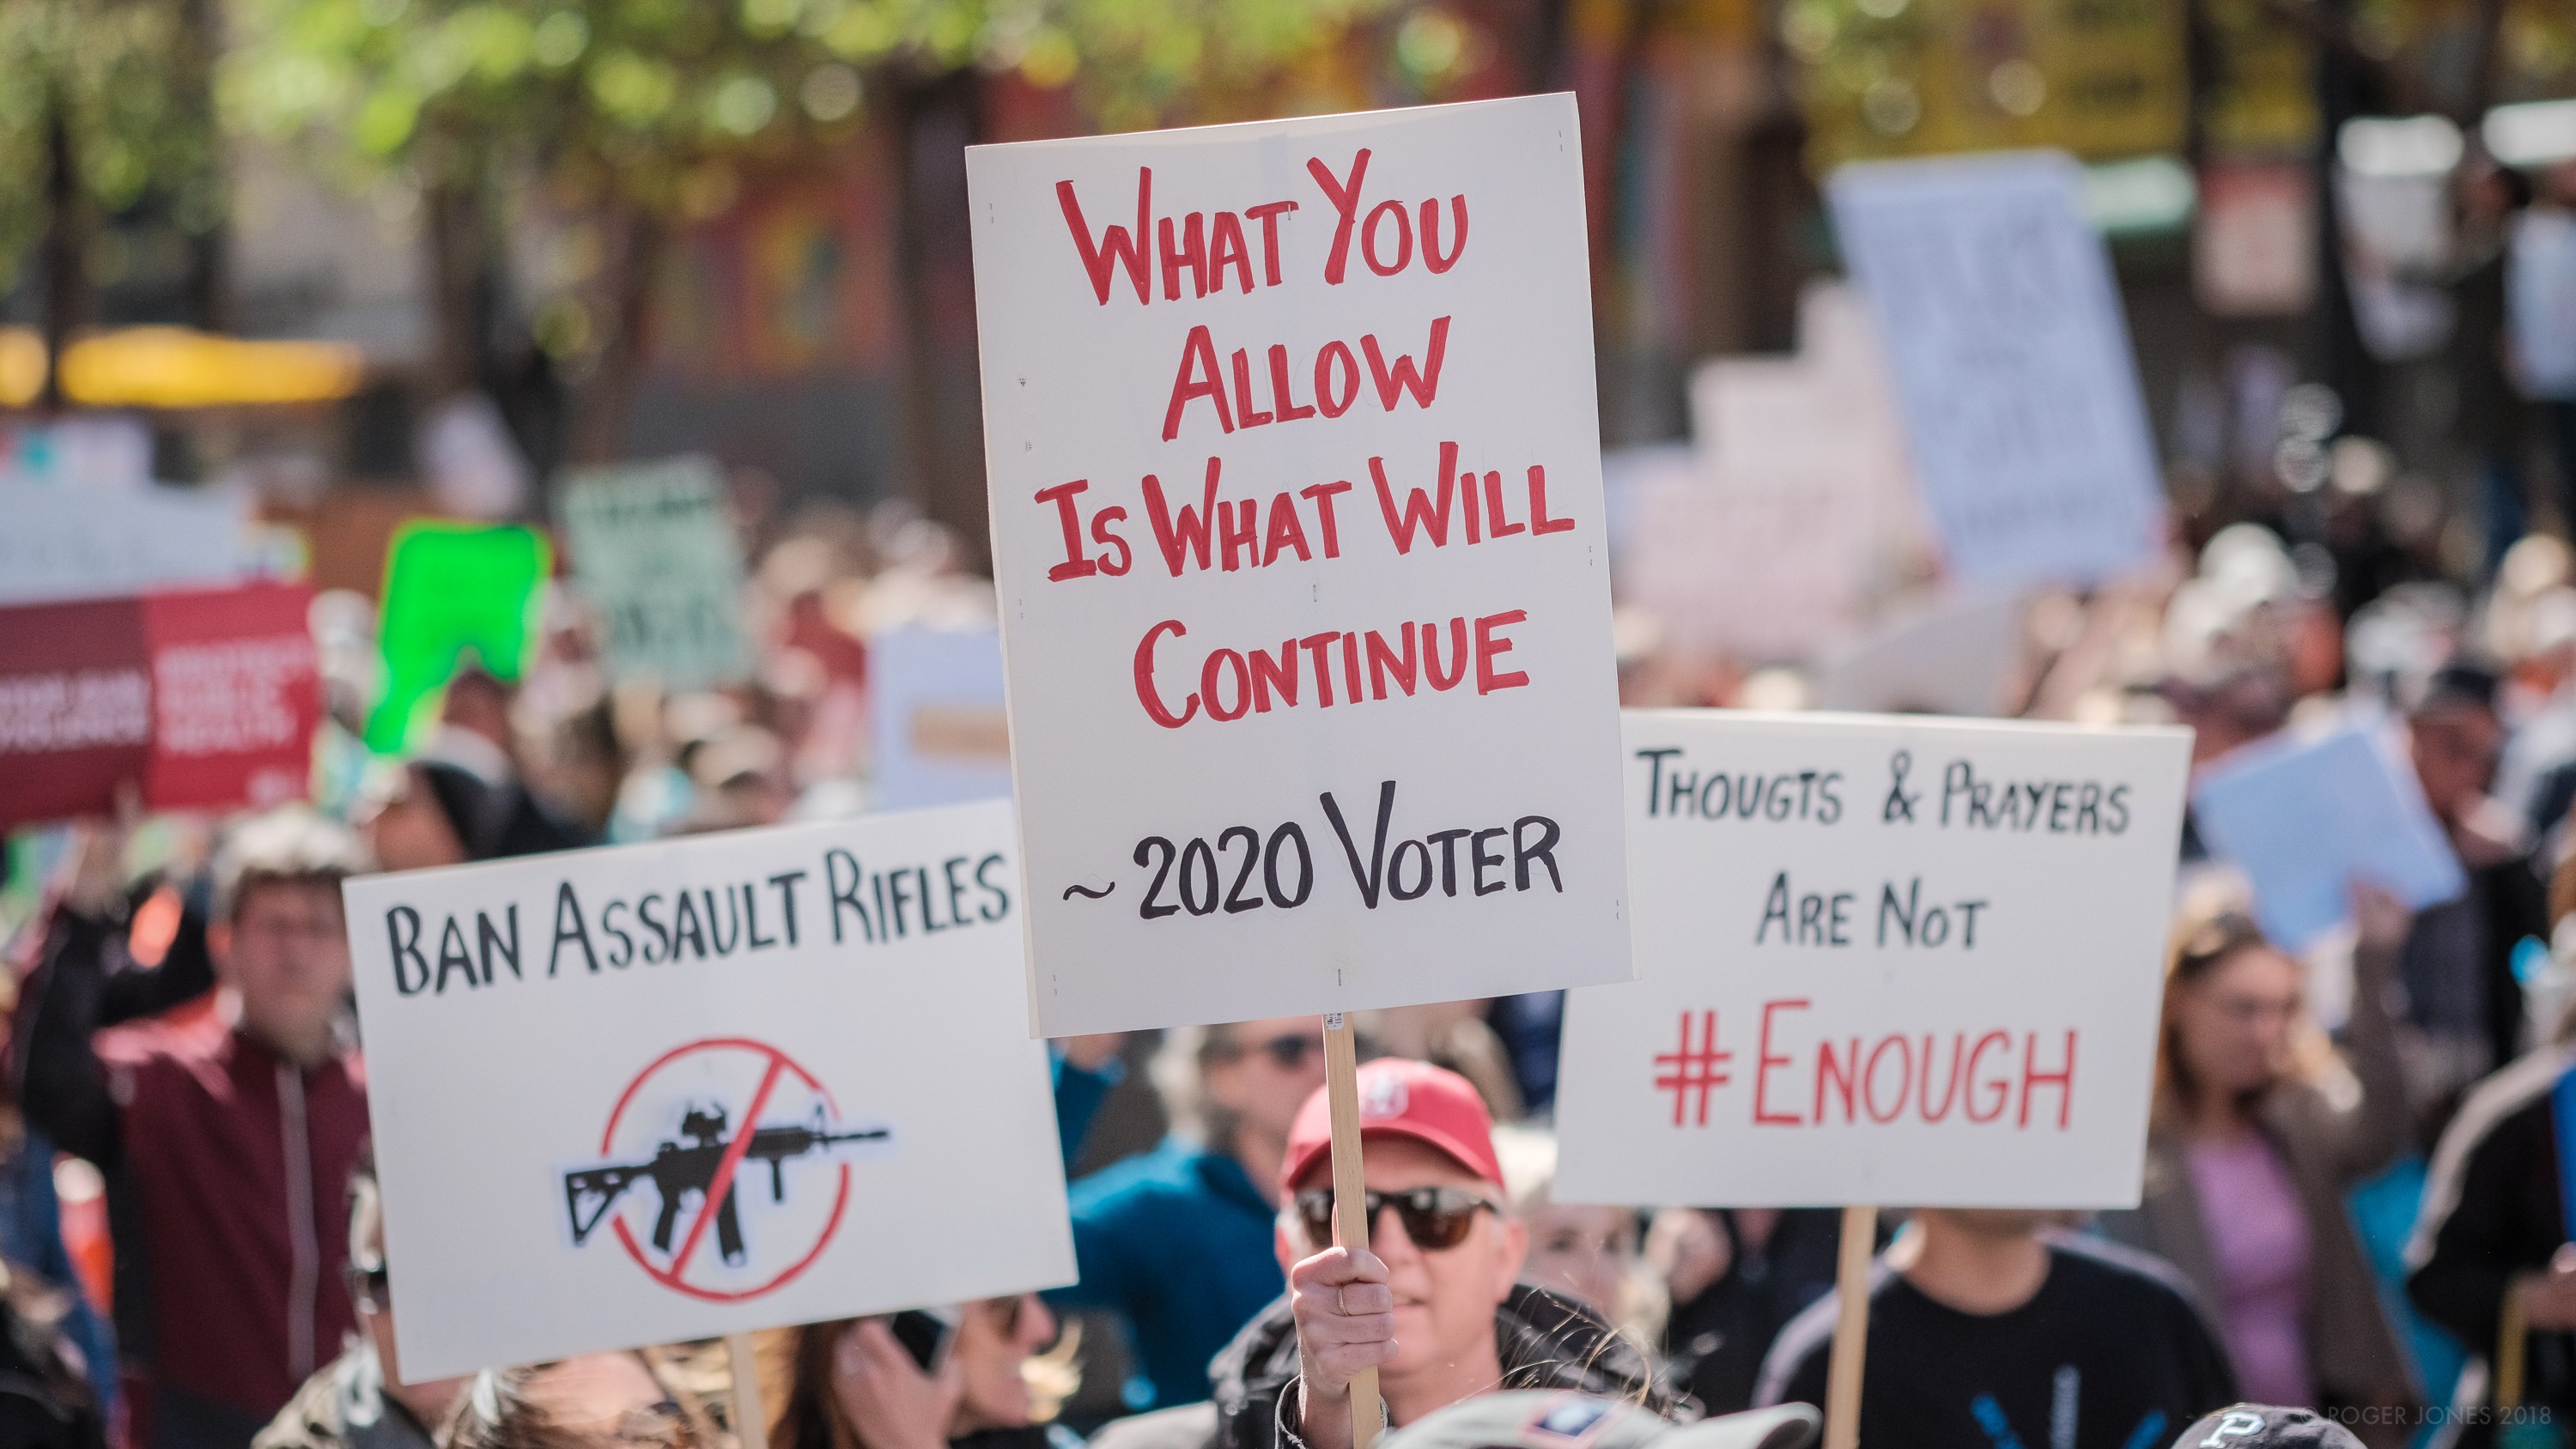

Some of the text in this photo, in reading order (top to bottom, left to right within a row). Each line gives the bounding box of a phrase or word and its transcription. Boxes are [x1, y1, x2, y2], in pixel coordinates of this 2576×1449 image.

[1056, 148, 1469, 306] WHAT YOU
[1162, 315, 1452, 442] ALLOW
[1034, 479, 1133, 582] IS
[1141, 456, 1352, 578] WHAT
[1368, 441, 1576, 555] WILL
[1133, 609, 1531, 729] CONTINUE
[1133, 821, 1314, 920] 2020
[1319, 779, 1564, 910] VOTER
[1635, 747, 2134, 835] THOUGTS & PRAYERS
[384, 848, 1012, 997] BAN ASSAULT RIFLES
[1754, 869, 1990, 950] ARE NOT
[1654, 997, 2078, 1131] #ENOUGH
[2198, 1410, 2266, 1449] P
